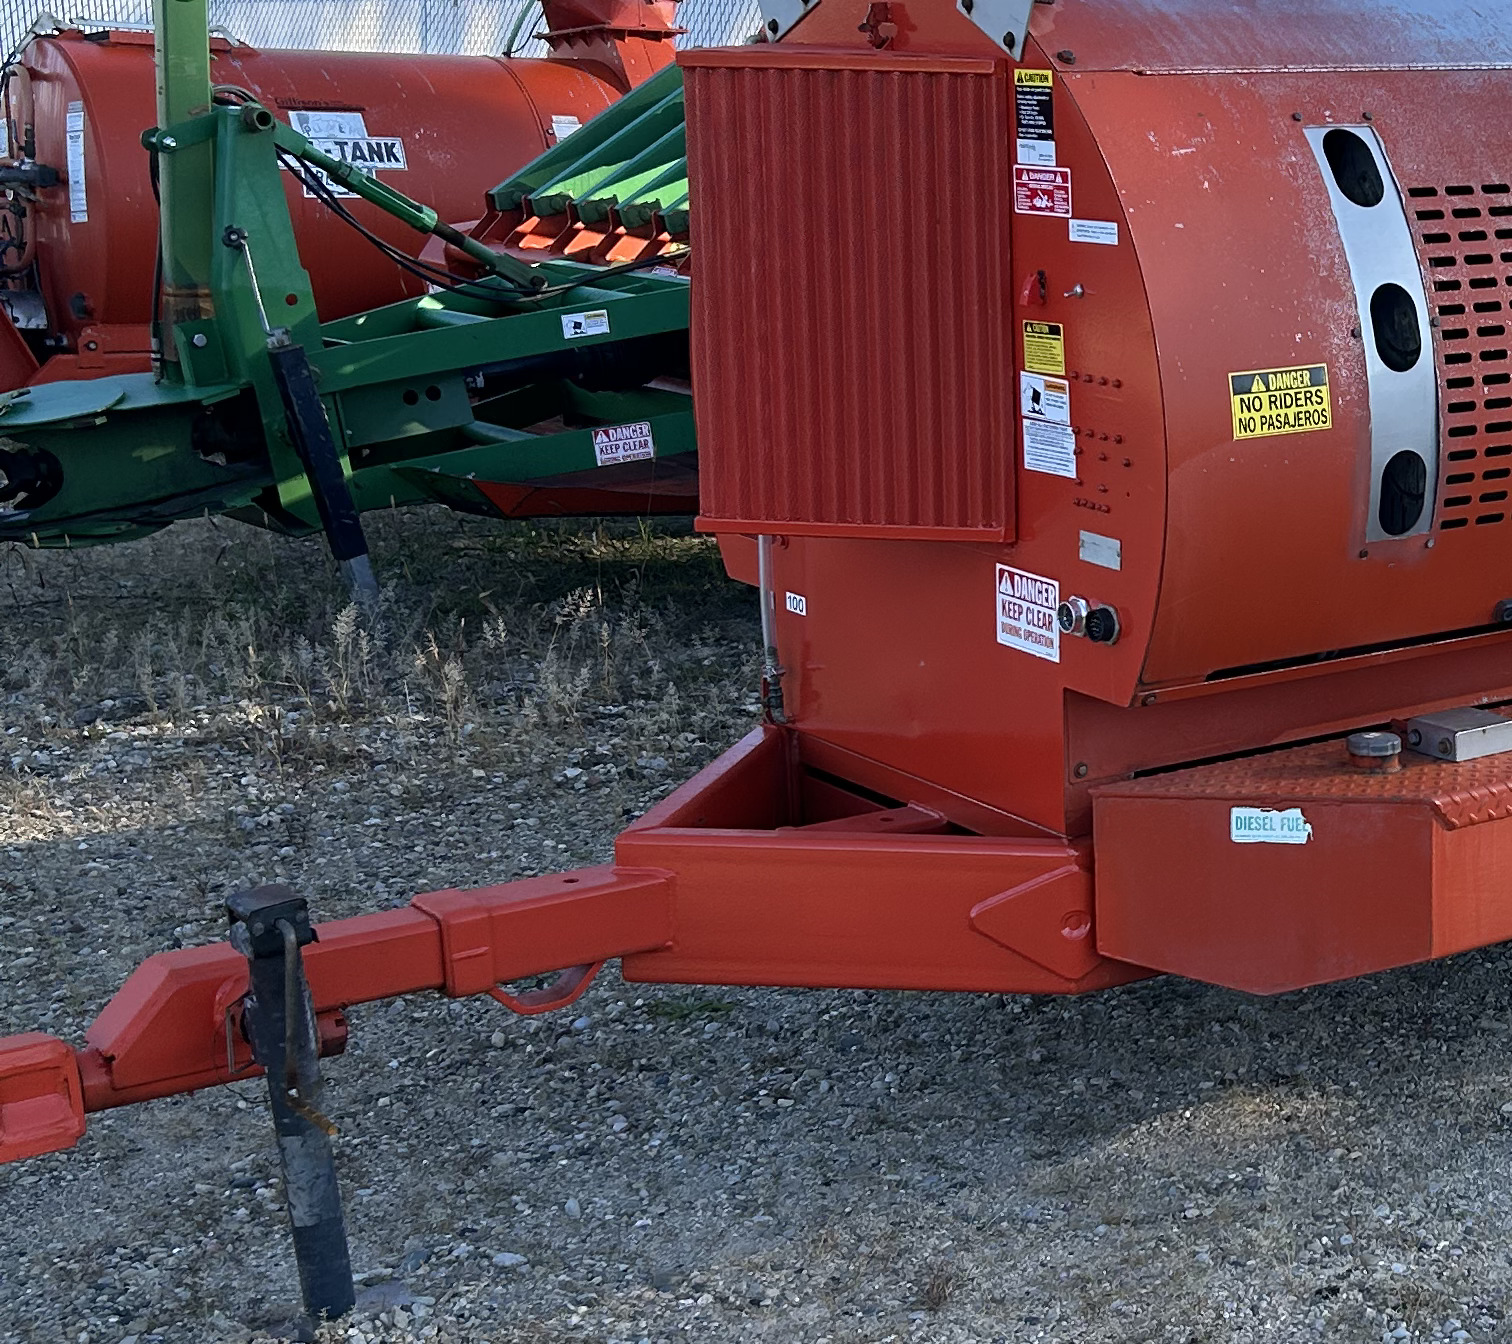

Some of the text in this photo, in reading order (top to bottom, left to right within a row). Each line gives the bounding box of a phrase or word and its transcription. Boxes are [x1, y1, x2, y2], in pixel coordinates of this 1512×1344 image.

[1268, 370, 1311, 391] DANGER
[1240, 389, 1324, 414] NO RIDERS
[1239, 408, 1328, 434] NO PASAJEROS
[608, 424, 649, 441] DANGER
[600, 439, 649, 455] KEEP CLEAR
[1014, 574, 1056, 609] DANGER
[787, 595, 804, 613] 100
[1001, 598, 1054, 633] KEEP CLEAR
[1235, 816, 1309, 832] DIESEL FUEL
